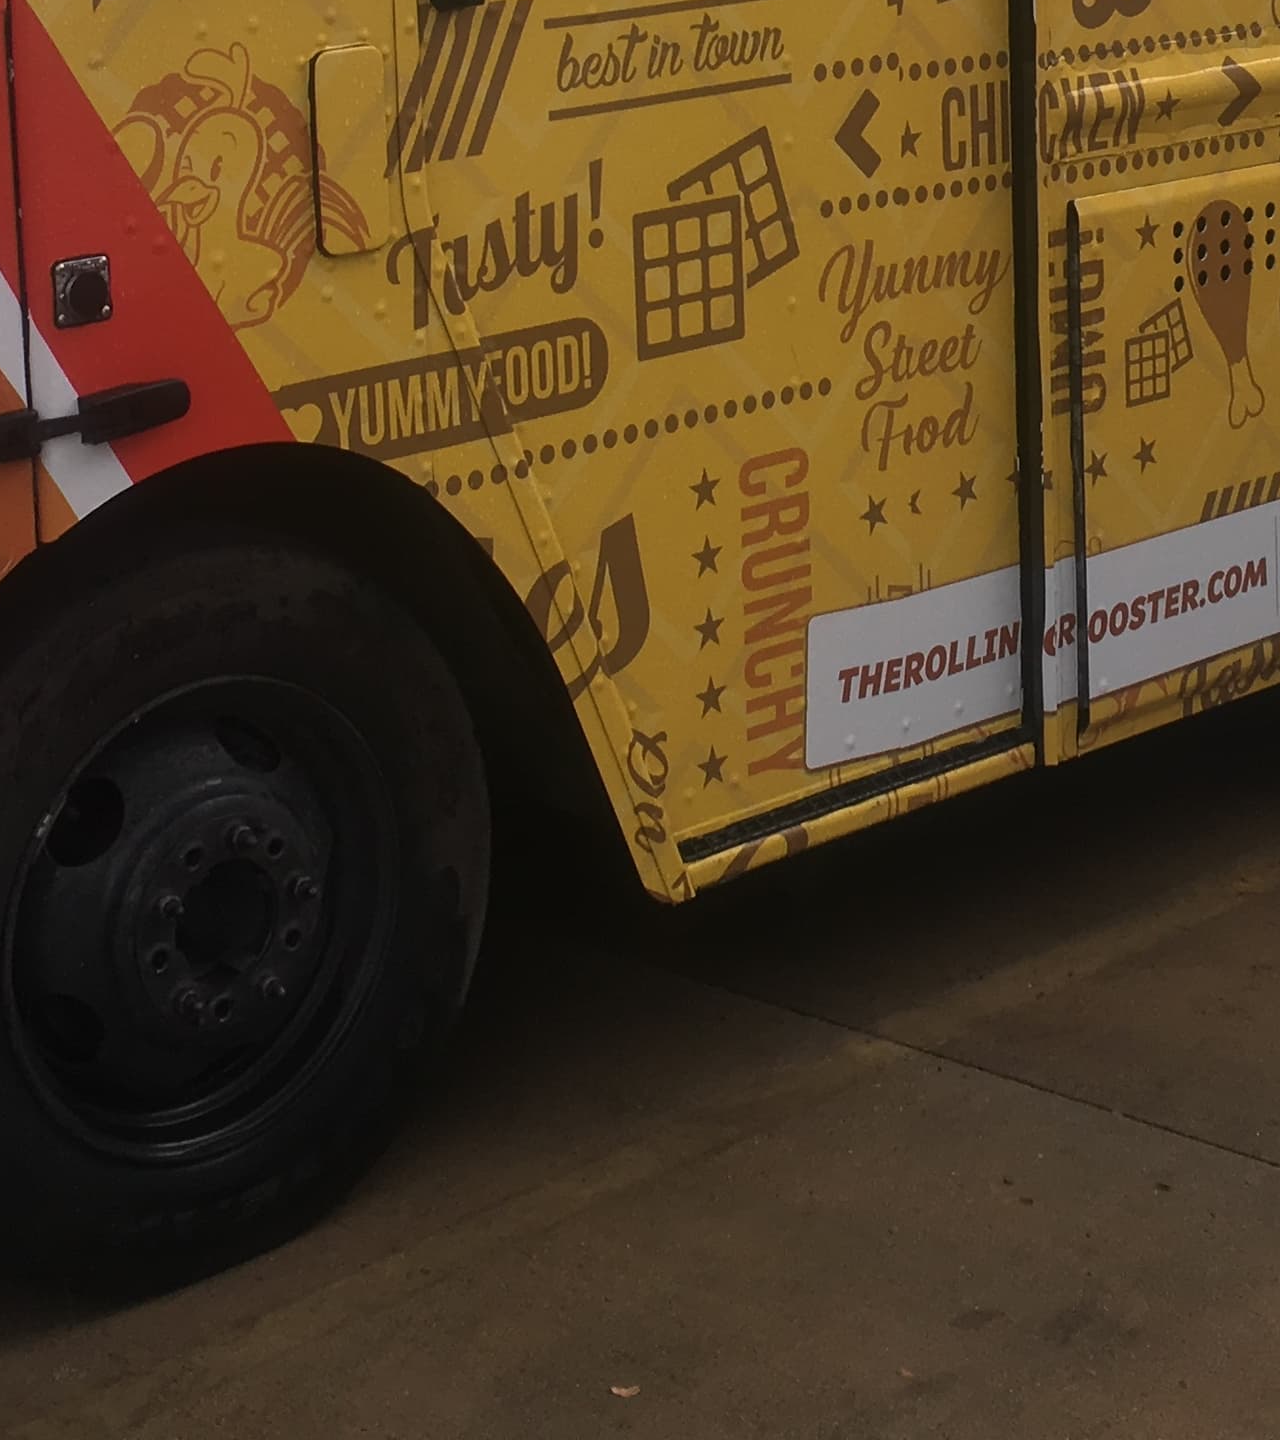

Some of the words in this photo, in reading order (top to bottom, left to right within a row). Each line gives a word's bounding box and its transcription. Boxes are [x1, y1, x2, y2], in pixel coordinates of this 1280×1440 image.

[556, 23, 649, 93] best
[647, 34, 684, 80] in
[689, 11, 785, 73] town
[941, 65, 1148, 173] CHICKEN
[386, 157, 605, 331] Tasty!
[818, 239, 1012, 345] Yummy
[328, 356, 489, 451] YUMMY
[484, 330, 593, 416] FOOD!
[855, 320, 984, 401] Street
[738, 446, 816, 778] CRUNCHY
